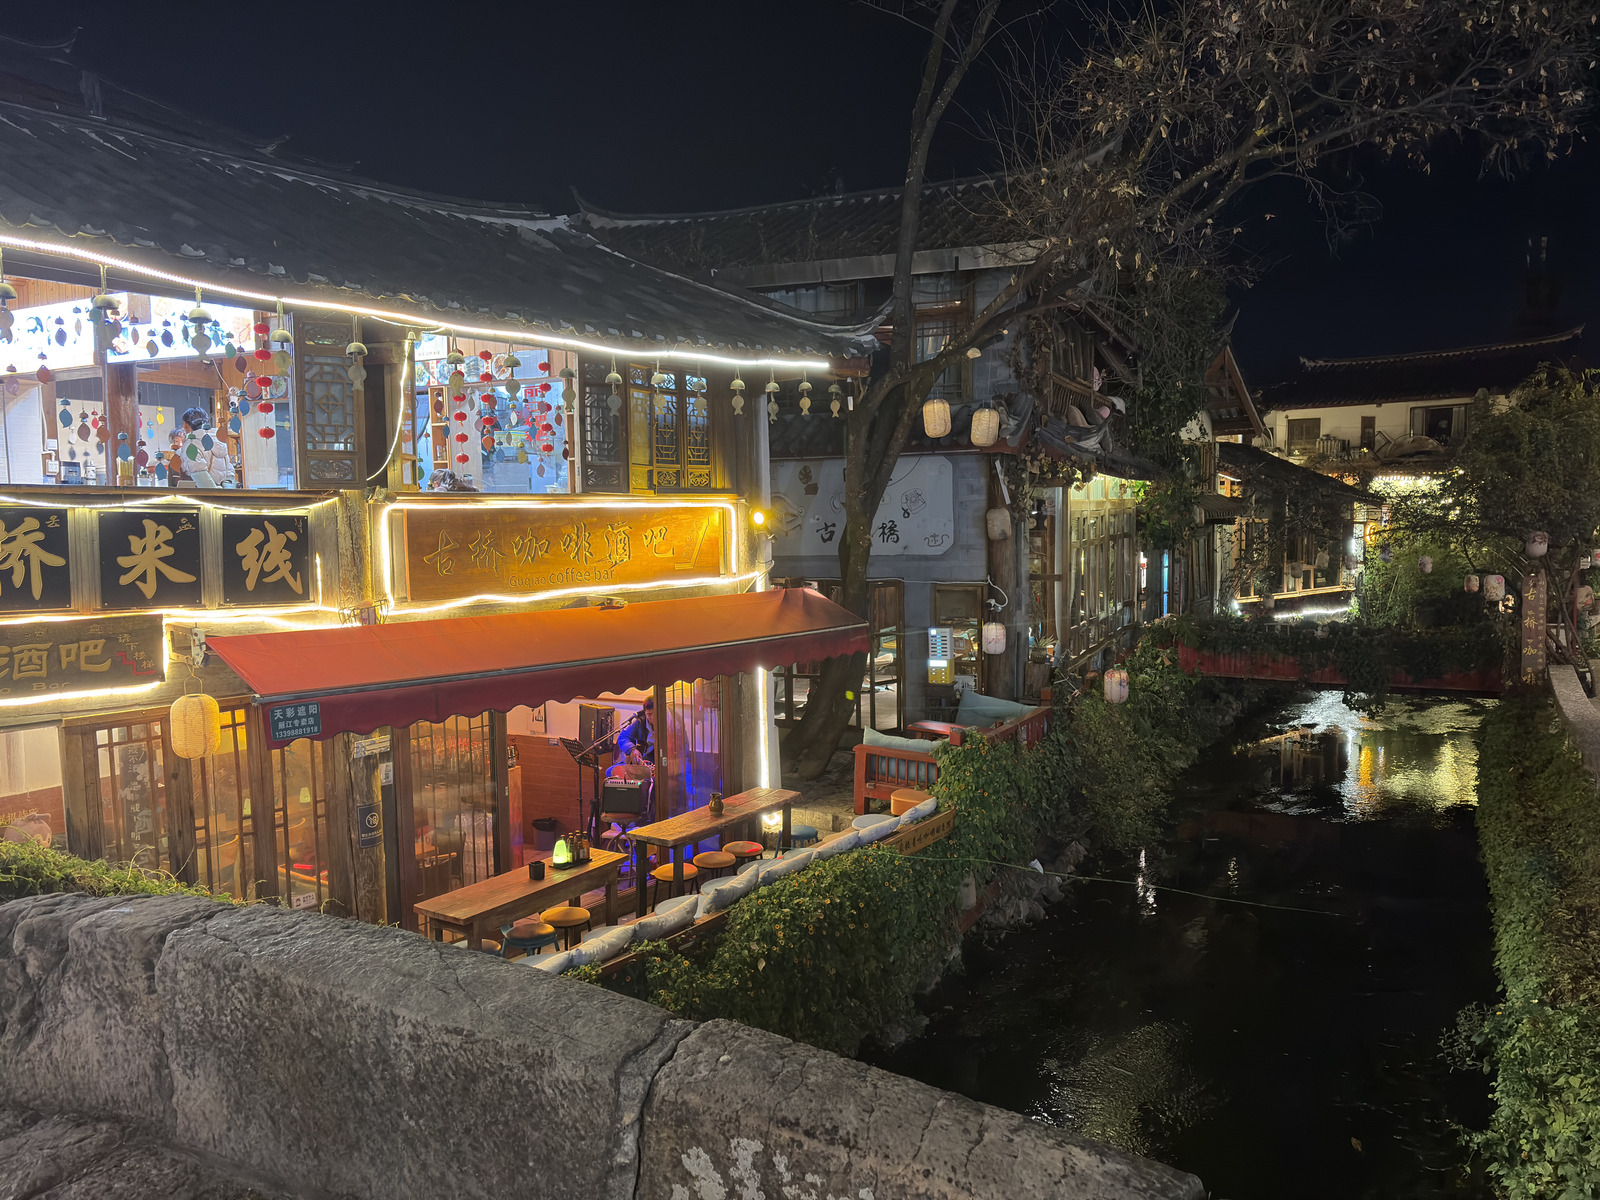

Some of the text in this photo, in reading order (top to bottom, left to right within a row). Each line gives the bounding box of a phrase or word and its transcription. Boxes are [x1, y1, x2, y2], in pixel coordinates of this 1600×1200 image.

[509, 566, 615, 588] Guqiao coffee bar
[32, 681, 71, 692] Bar
[273, 704, 318, 720] 天彩遮阳
[278, 717, 315, 730] 丽江专卖店
[275, 726, 318, 738] 13398881918
